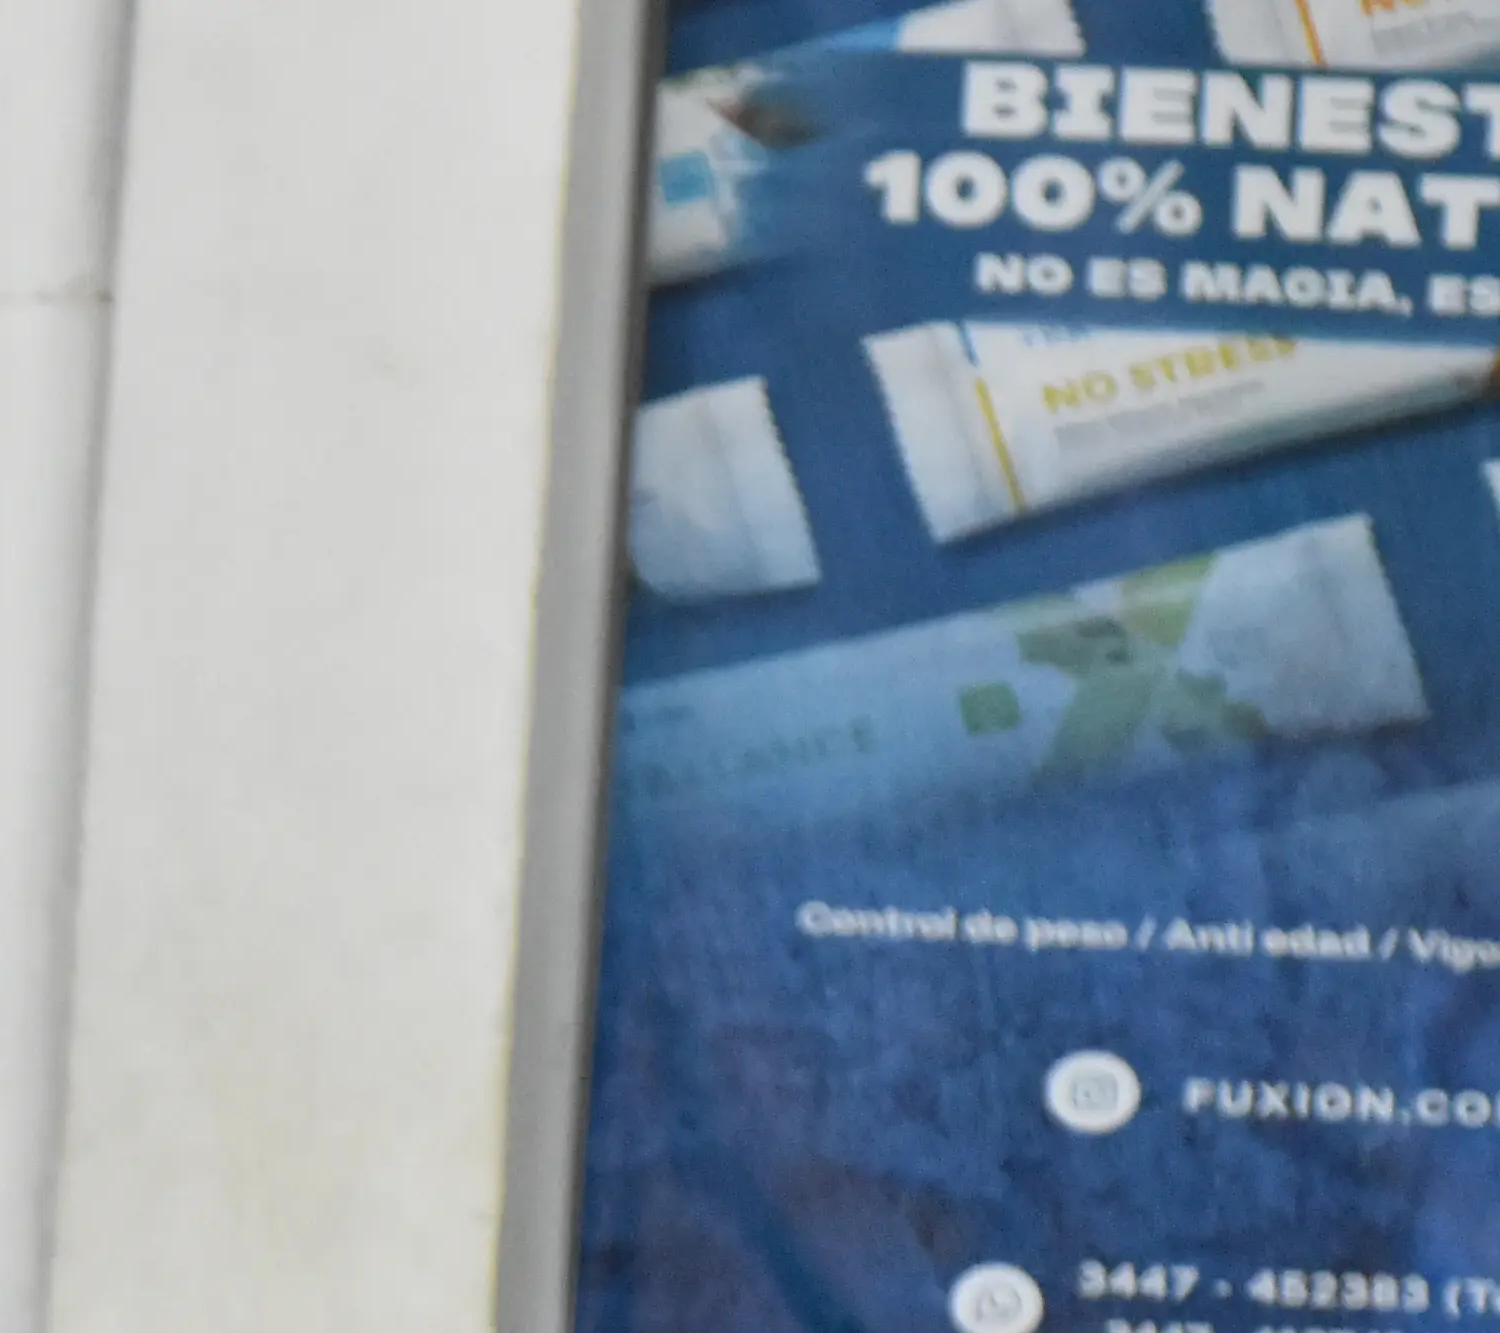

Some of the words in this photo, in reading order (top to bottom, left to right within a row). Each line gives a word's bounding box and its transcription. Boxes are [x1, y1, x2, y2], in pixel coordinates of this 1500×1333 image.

[864, 148, 1203, 238] 100%
[1233, 164, 1500, 250] NAT
[974, 251, 1073, 296] NO
[1088, 257, 1167, 300] ES
[796, 900, 957, 943] Control
[964, 907, 1018, 945] de
[1024, 915, 1129, 952] peso
[1163, 917, 1256, 955] Anti
[1260, 924, 1371, 961] edad
[1182, 1075, 1500, 1129] FUXION.CO
[1078, 1258, 1198, 1301] 3447
